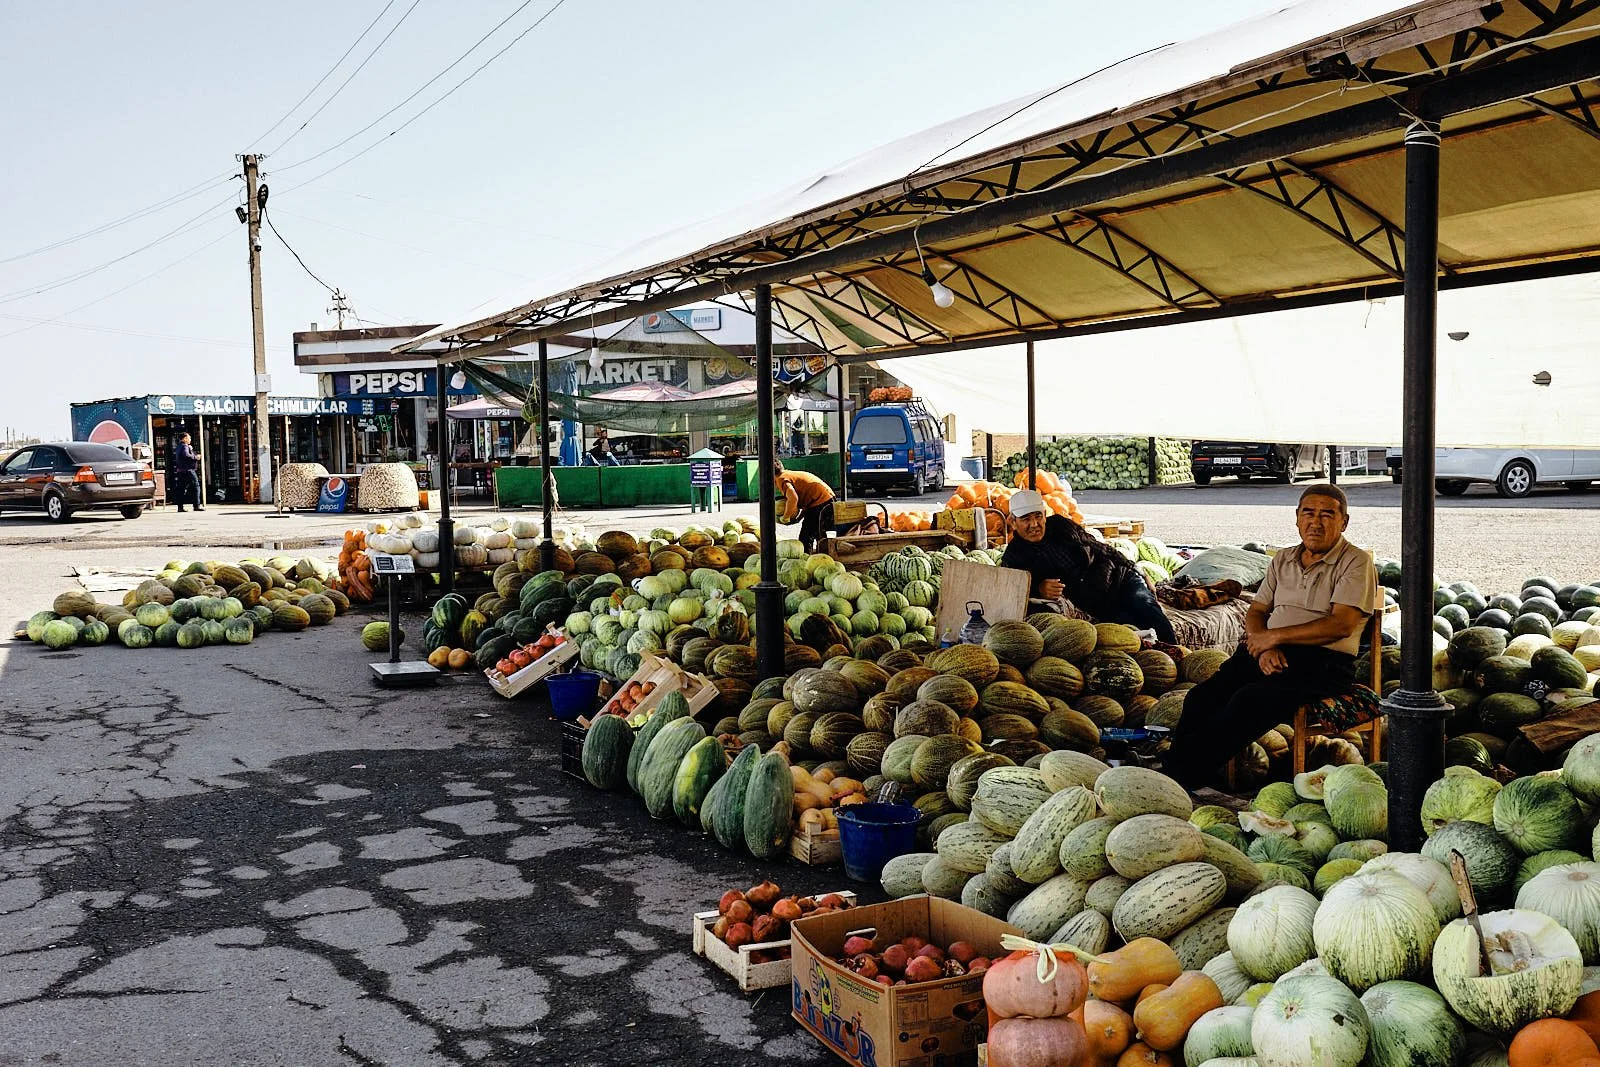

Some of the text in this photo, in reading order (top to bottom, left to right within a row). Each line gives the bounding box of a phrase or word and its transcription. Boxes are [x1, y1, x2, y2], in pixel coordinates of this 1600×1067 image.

[349, 371, 425, 394] PEPSI
[267, 400, 348, 413] CHIMLIKLAR
[486, 408, 510, 416] PEPSI
[320, 503, 340, 511] pepsi
